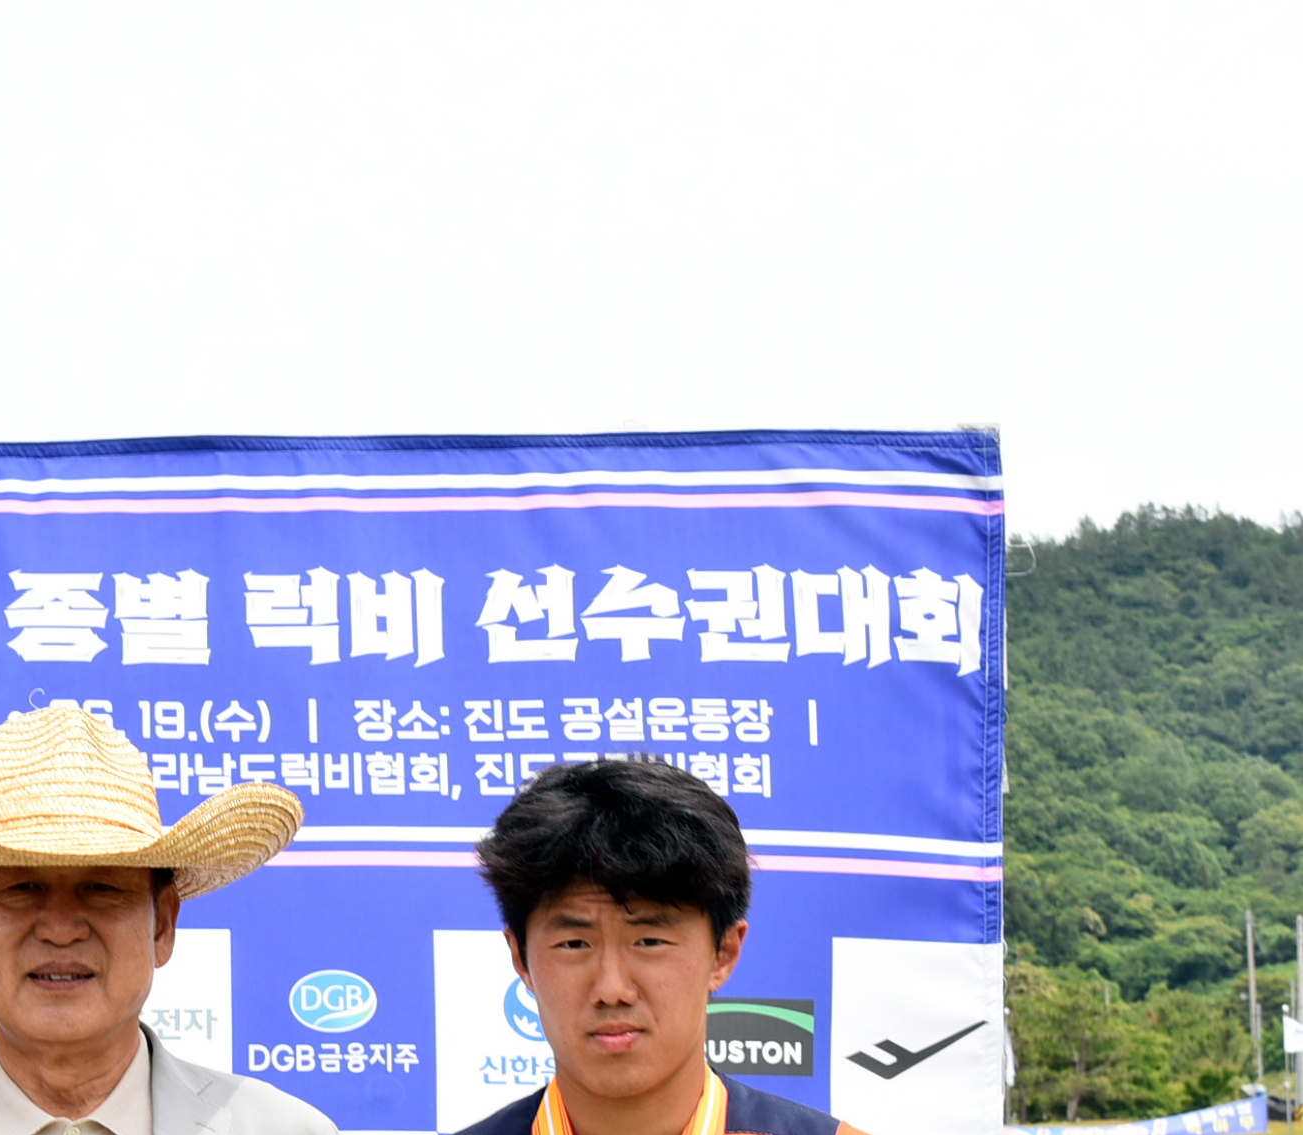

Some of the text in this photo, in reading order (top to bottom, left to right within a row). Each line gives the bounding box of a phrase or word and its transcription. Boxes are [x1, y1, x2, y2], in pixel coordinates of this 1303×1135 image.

[4, 567, 211, 666] 종별
[243, 565, 446, 668] 럭비
[475, 563, 984, 677] 선수권대회
[138, 699, 271, 743] 19.(수)
[353, 698, 451, 742] 장소:
[463, 698, 549, 742] 진도
[560, 697, 774, 743] 공설운동장
[300, 984, 365, 1012] DGB
[248, 1042, 420, 1074] DGB금융지주
